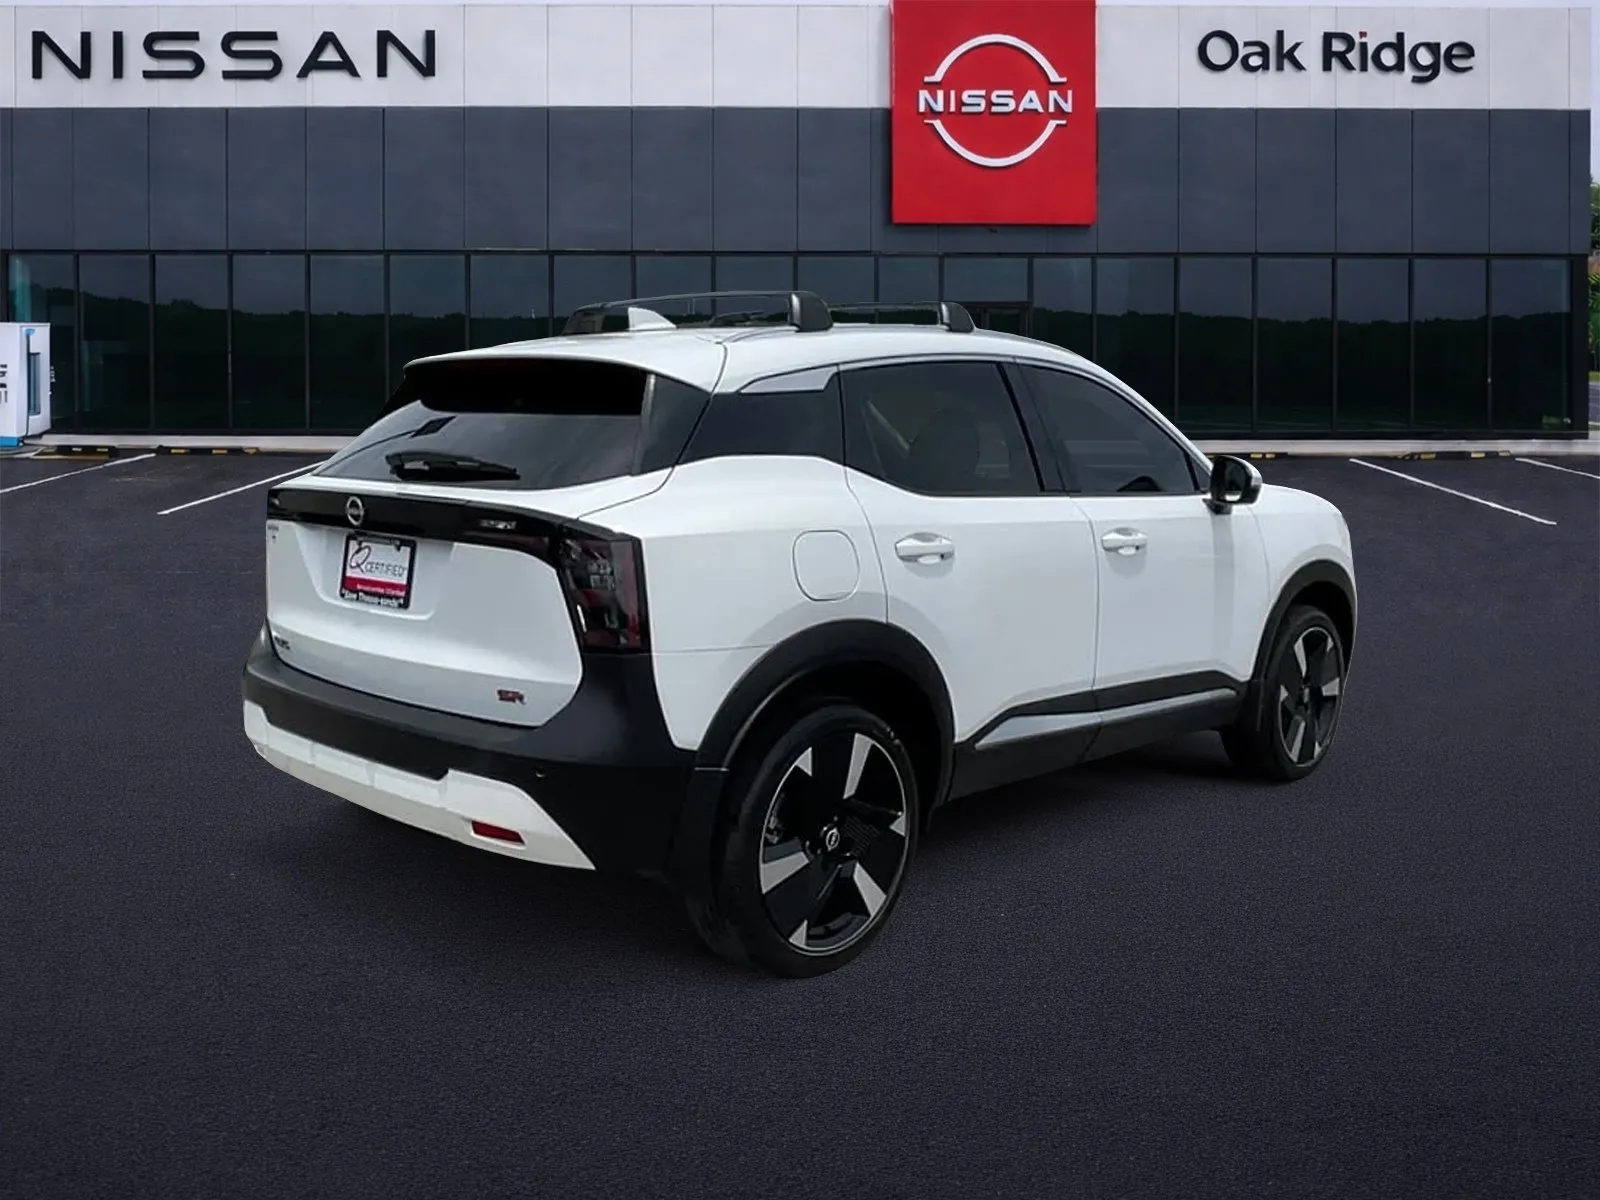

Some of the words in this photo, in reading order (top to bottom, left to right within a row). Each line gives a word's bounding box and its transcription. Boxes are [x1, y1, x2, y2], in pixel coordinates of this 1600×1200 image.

[32, 30, 436, 79] NISSAN
[1198, 30, 1306, 72] Oak
[1322, 31, 1475, 84] Ridge
[918, 89, 1073, 113] NISSAN
